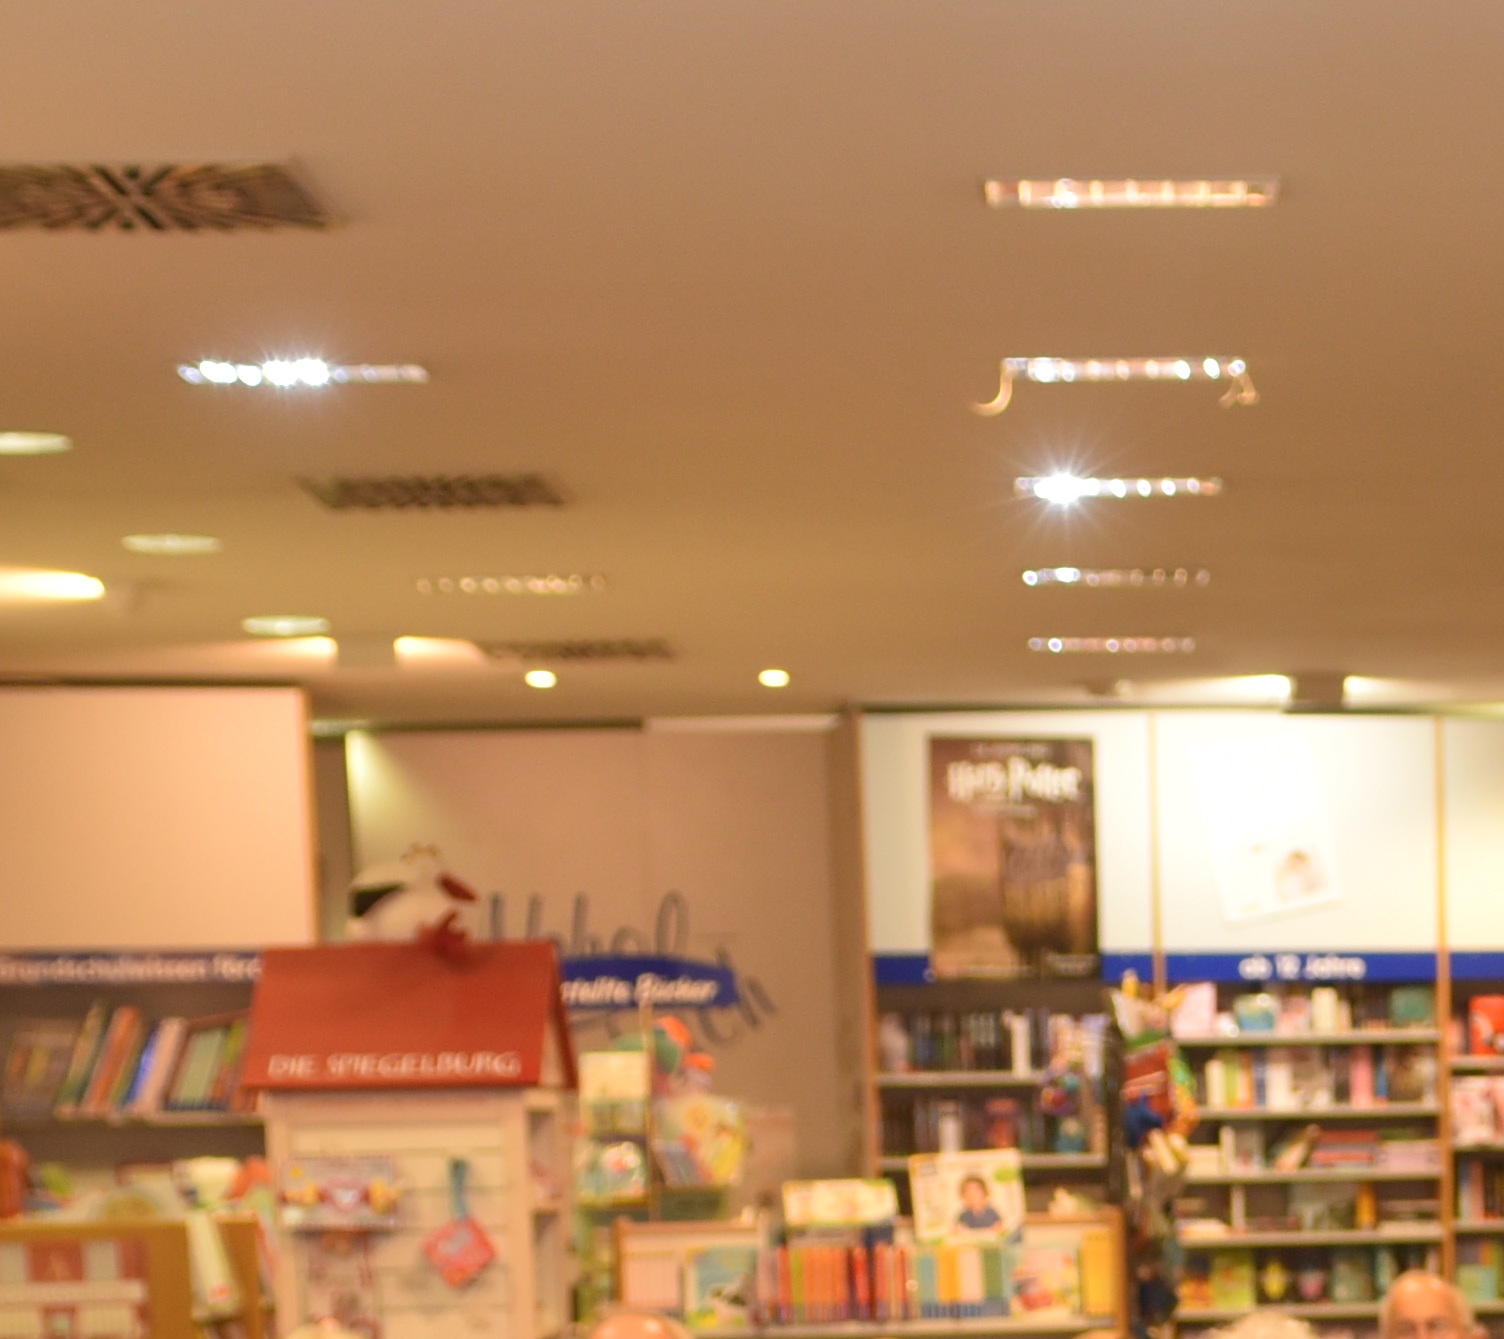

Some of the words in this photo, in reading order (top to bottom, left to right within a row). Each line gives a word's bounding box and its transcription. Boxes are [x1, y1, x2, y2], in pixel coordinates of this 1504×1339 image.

[1239, 954, 1272, 980] ab
[1303, 953, 1367, 980] Jahre
[268, 1054, 316, 1079] DIE
[326, 1050, 522, 1079] SPIEGELBURG
